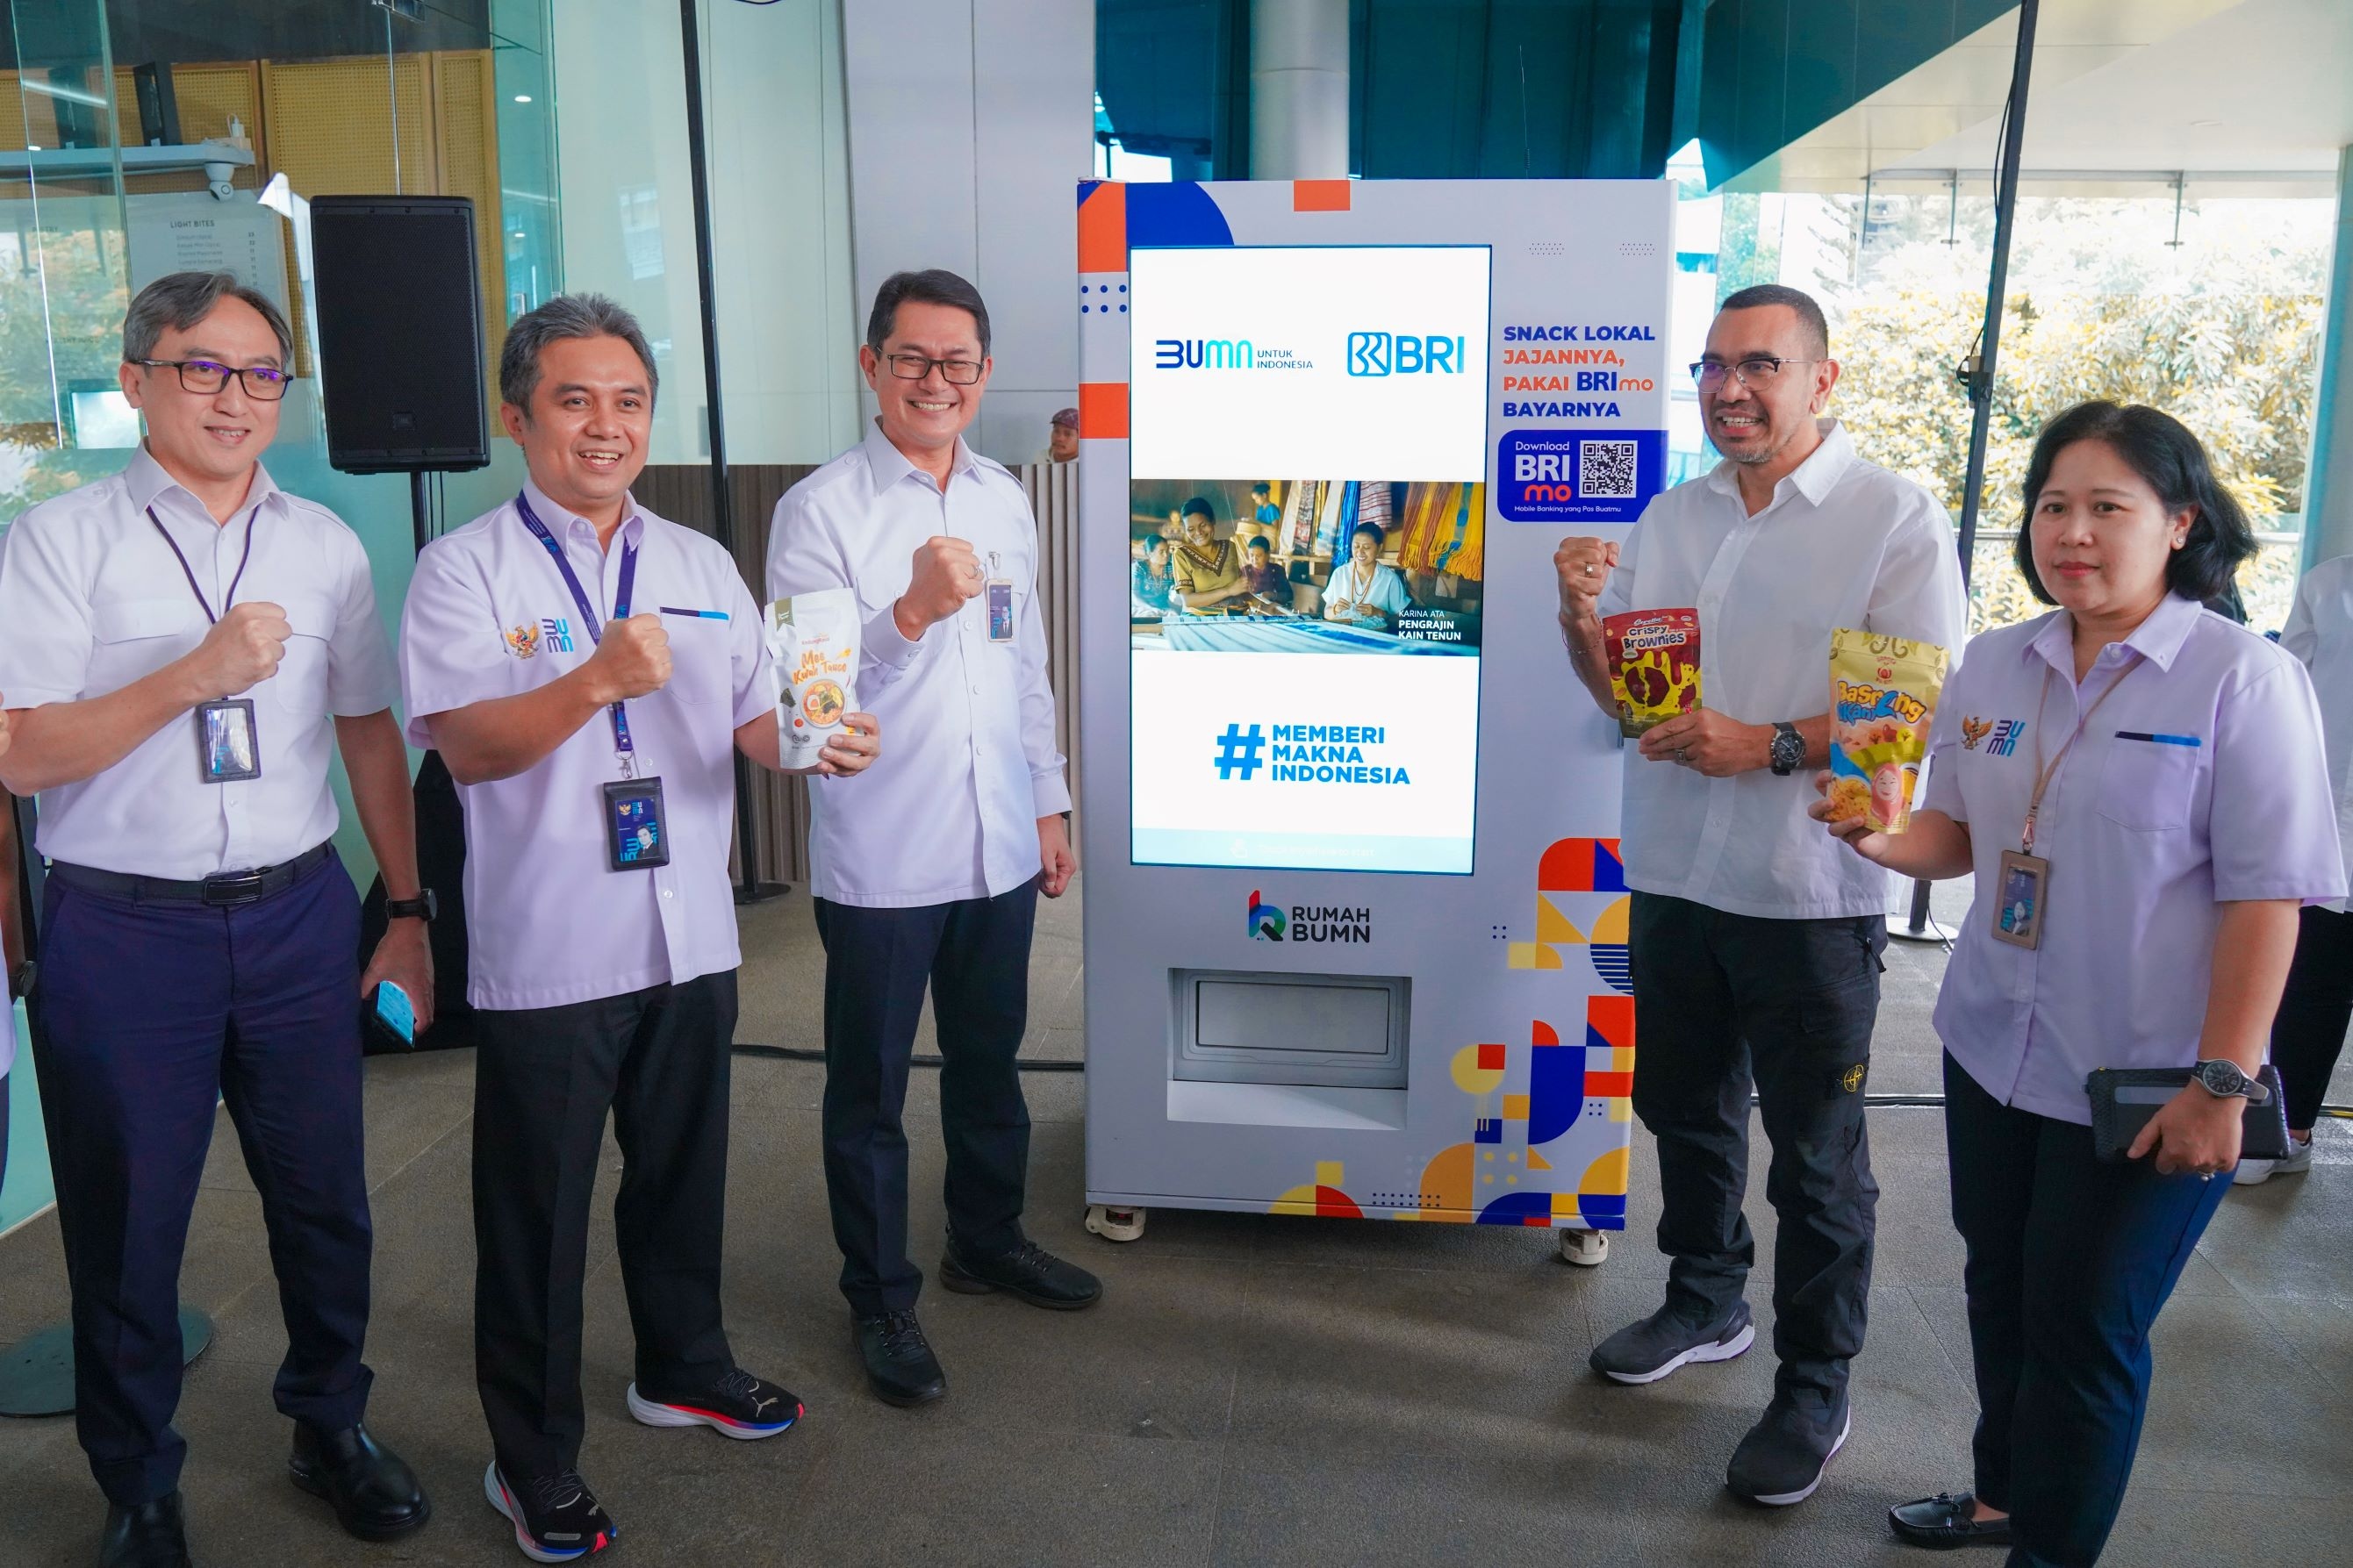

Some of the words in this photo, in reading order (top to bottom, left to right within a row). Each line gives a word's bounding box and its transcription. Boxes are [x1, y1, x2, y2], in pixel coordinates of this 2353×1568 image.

[1503, 326, 1579, 341] SNACK
[1584, 326, 1656, 341] LOKAL
[1156, 340, 1252, 369] BUMN
[1257, 349, 1293, 358] UNTUK
[1395, 335, 1465, 374] BRI
[1503, 349, 1625, 367] JAJANNYA,
[1257, 361, 1314, 369] INDONESIA
[1503, 376, 1569, 391] PAKAI
[1576, 371, 1654, 391] BRImo
[1503, 402, 1621, 417] BAYARNYA
[1515, 440, 1570, 451] Download
[1515, 455, 1570, 482] BRI
[1524, 484, 1572, 502] mo
[1398, 619, 1454, 631] PENGRAJIN
[1398, 631, 1424, 640] KAIN
[1426, 631, 1461, 641] TENUN
[1837, 680, 1927, 724] Basrng
[1273, 725, 1385, 744] MEMBERI
[1273, 744, 1364, 763] MAKNA
[1273, 764, 1410, 784] INDONESIA
[1292, 906, 1370, 923] RUMAH
[1292, 923, 1370, 943] BUMN
